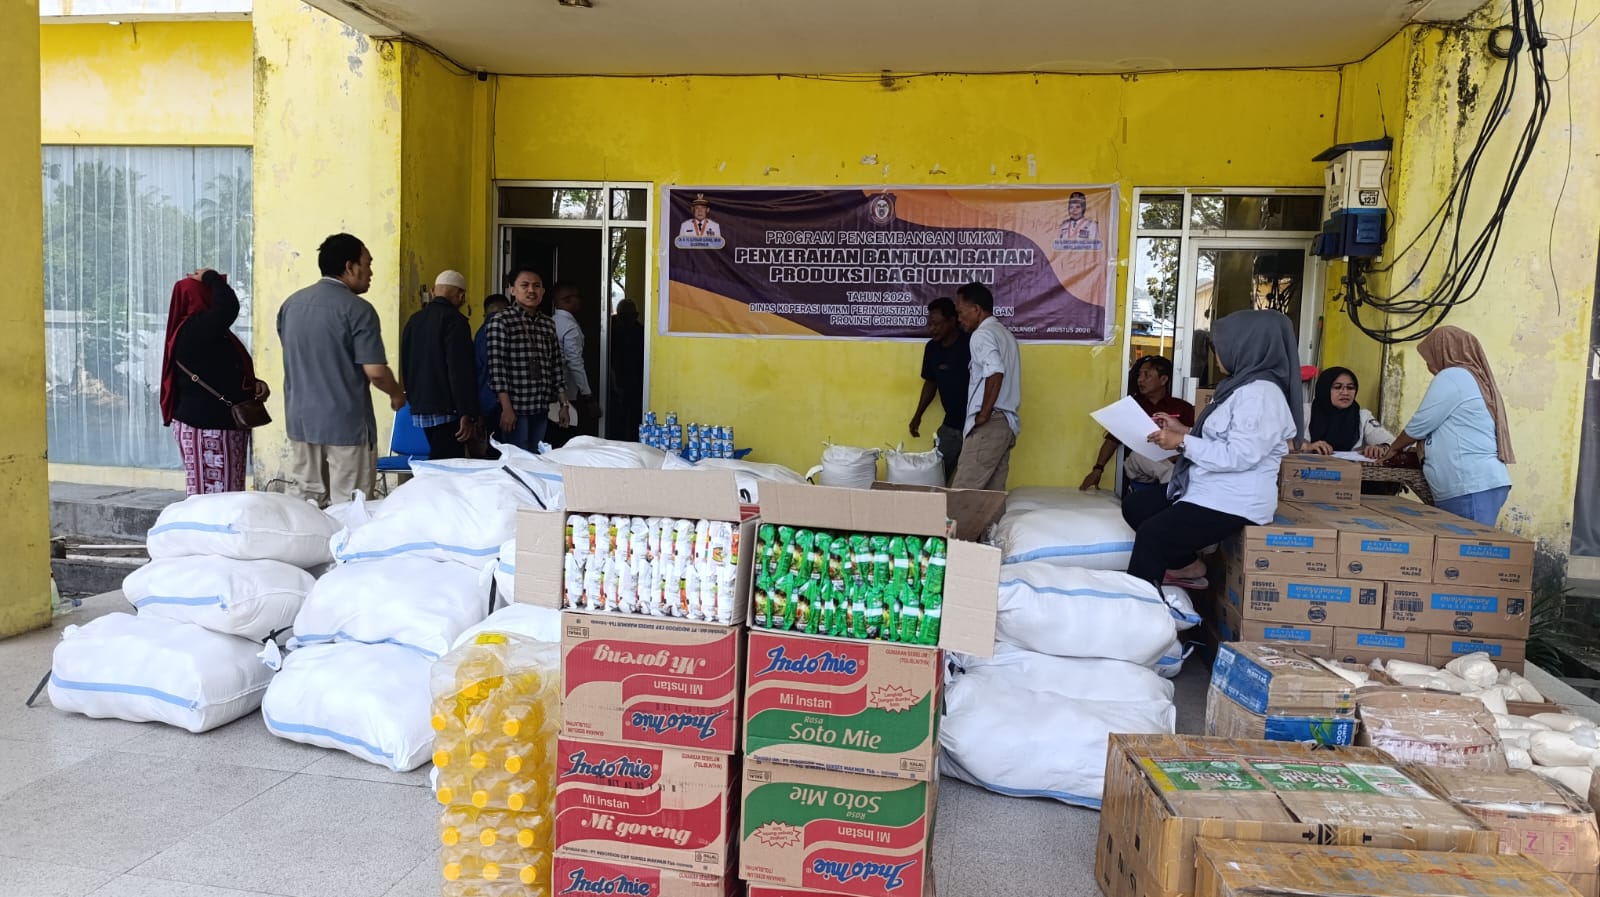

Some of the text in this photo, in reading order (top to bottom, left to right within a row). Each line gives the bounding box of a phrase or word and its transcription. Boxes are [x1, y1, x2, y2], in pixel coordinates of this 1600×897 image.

[766, 231, 1003, 245] PROGRAM PENGEMBANGAN UMKM
[735, 248, 1034, 265] PENYERAHAN BANTUAN BAHAN
[770, 266, 994, 284] PRODUKSI BAGI UMKM
[846, 291, 911, 302] TAHUN 2026
[749, 303, 776, 313] DINAS
[777, 303, 820, 314] KOPERASI
[821, 304, 849, 314] UMKM
[851, 304, 922, 315] PERINDUSTRIAN
[830, 315, 927, 326] PROVINSI GORONTALO
[593, 644, 706, 675] Mi goreng
[654, 681, 703, 695] Mi Instan
[779, 693, 832, 709] Mi Instan
[804, 716, 824, 725] Rasa
[788, 722, 882, 749] Soto Mie
[583, 794, 630, 810] Mi Instan
[790, 786, 882, 814] Soto Mie
[846, 811, 866, 820] Rasa
[581, 813, 692, 846] Mi goreng
[838, 826, 891, 843] Mi Instan
